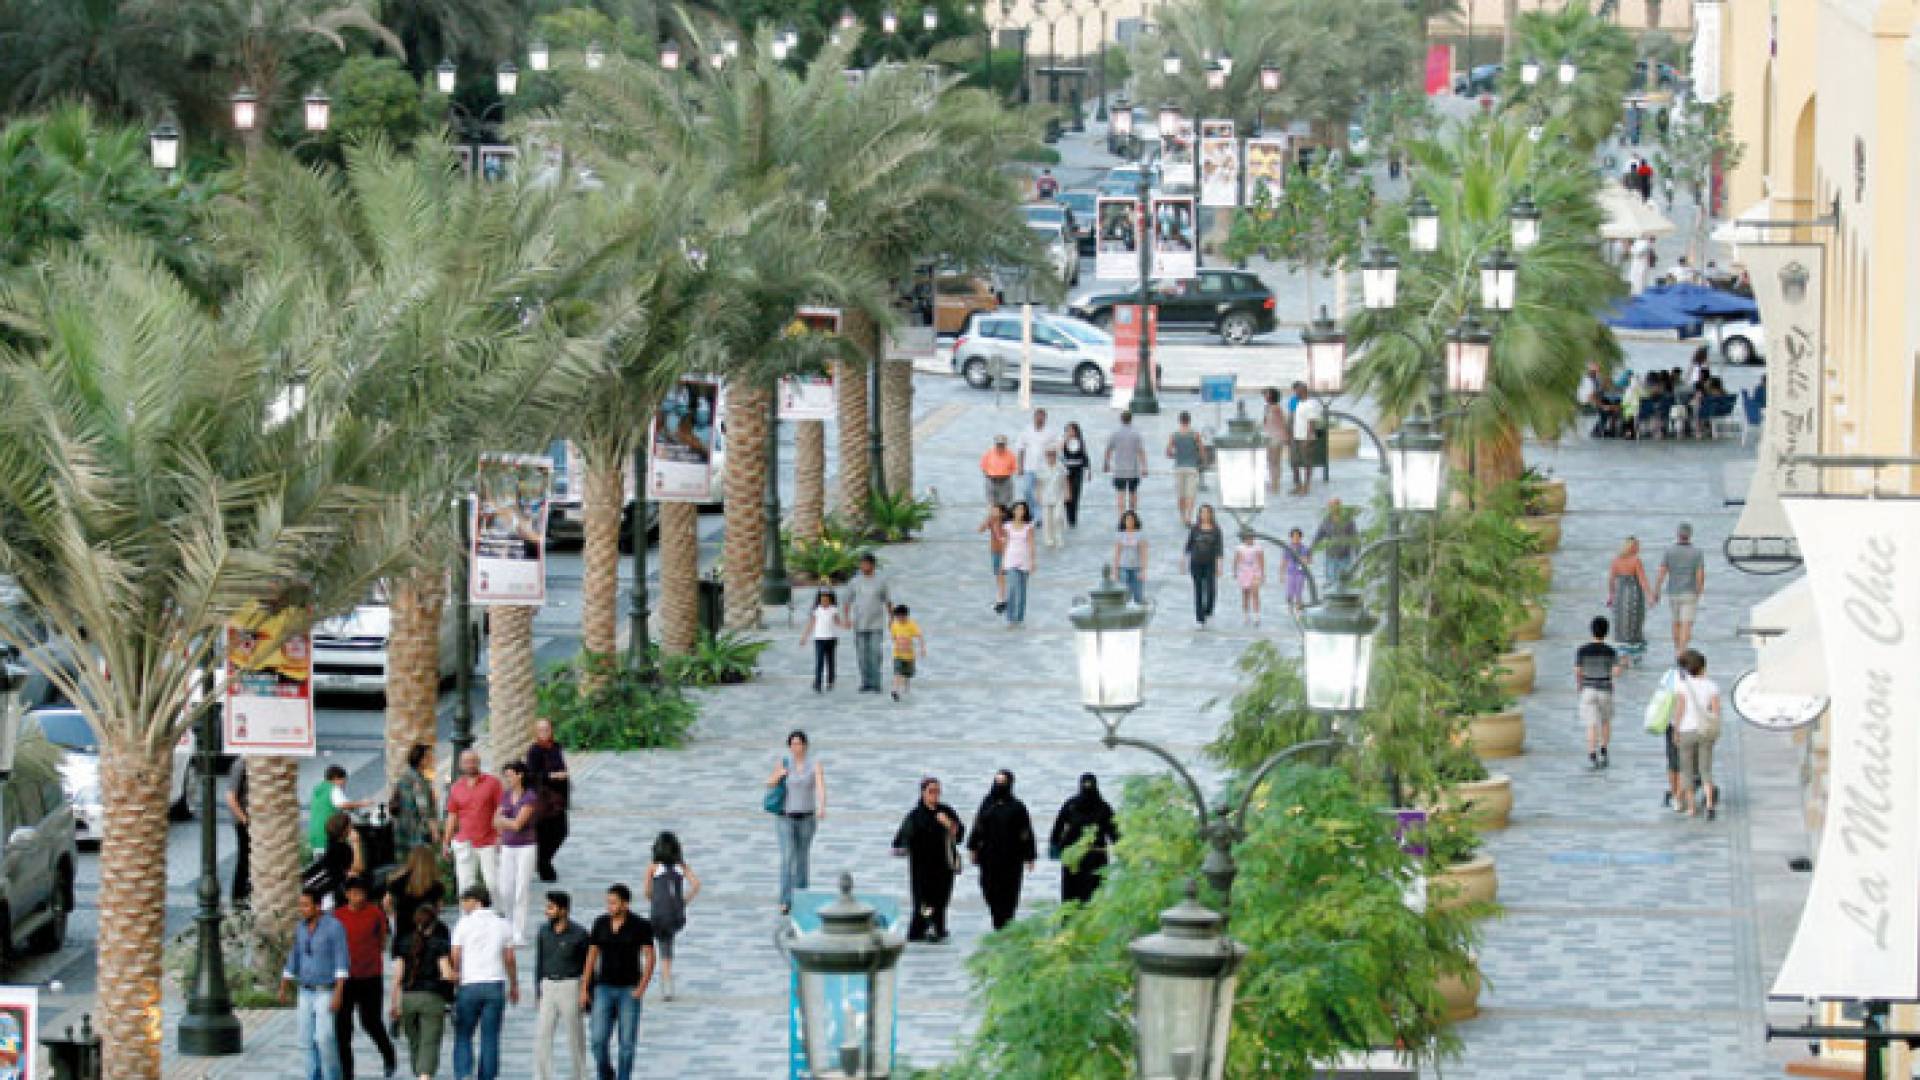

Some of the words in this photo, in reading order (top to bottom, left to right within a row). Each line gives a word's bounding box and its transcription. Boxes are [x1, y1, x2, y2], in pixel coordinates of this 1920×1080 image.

[1844, 534, 1903, 645] Chic
[1843, 668, 1892, 856] Maison
[1840, 873, 1889, 950] La
